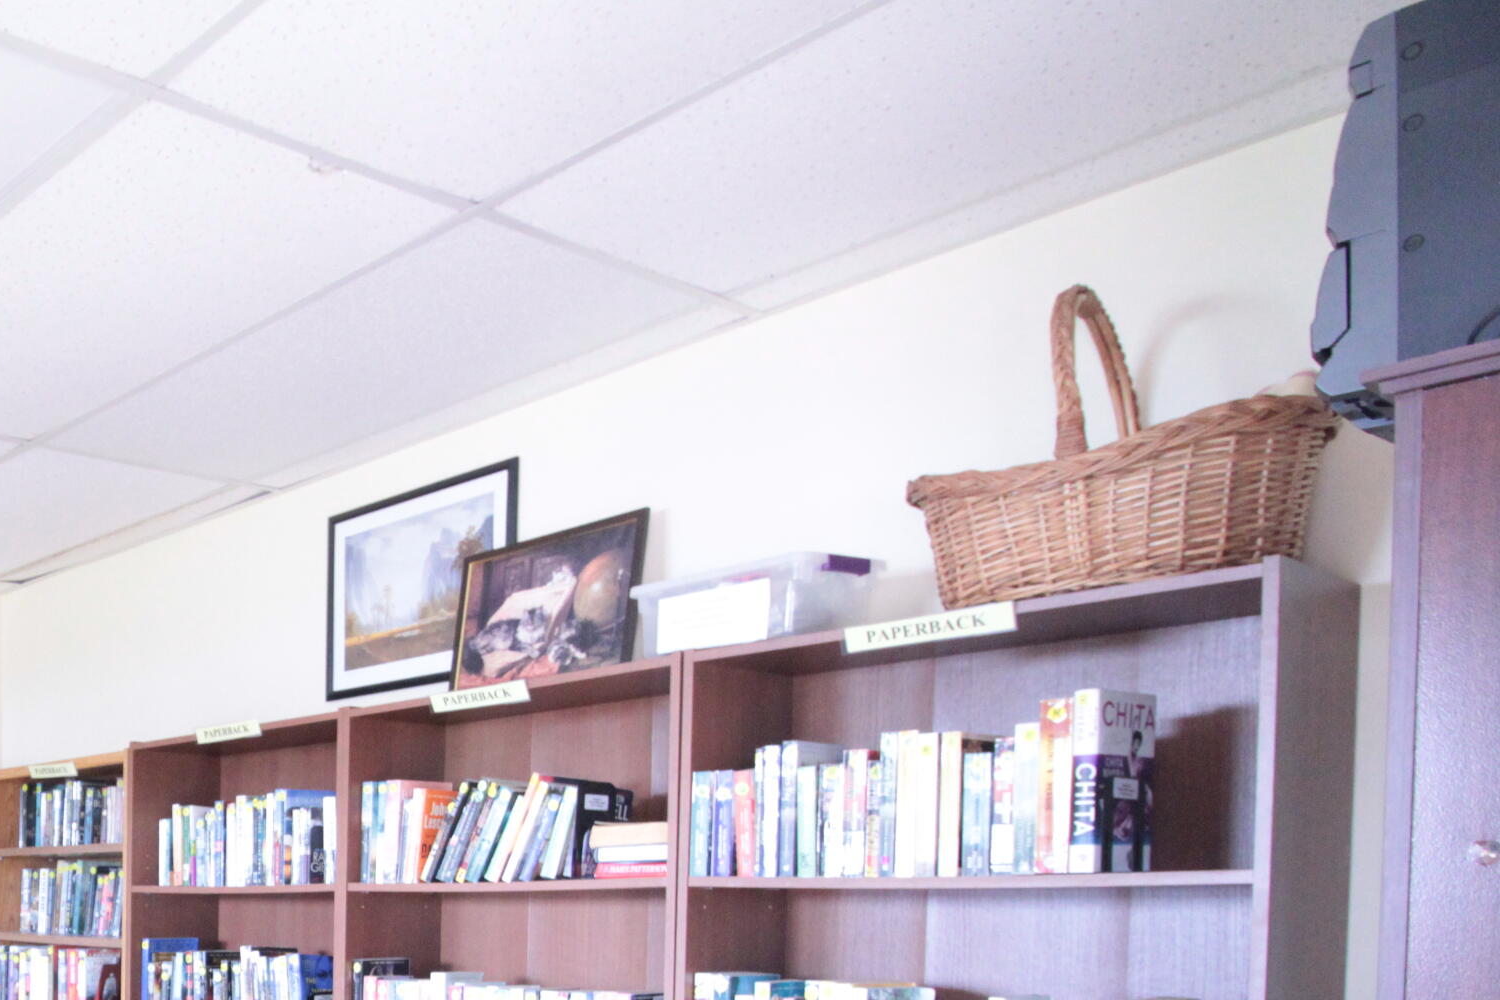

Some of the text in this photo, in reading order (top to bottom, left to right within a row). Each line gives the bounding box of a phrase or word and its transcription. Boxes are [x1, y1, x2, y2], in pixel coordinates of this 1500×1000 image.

[866, 612, 986, 643] PAPERBACK
[442, 687, 512, 706] PAPERBACK
[1101, 700, 1156, 728] CHITA
[203, 724, 250, 739] PAPERBACK
[1073, 763, 1097, 836] CHITA
